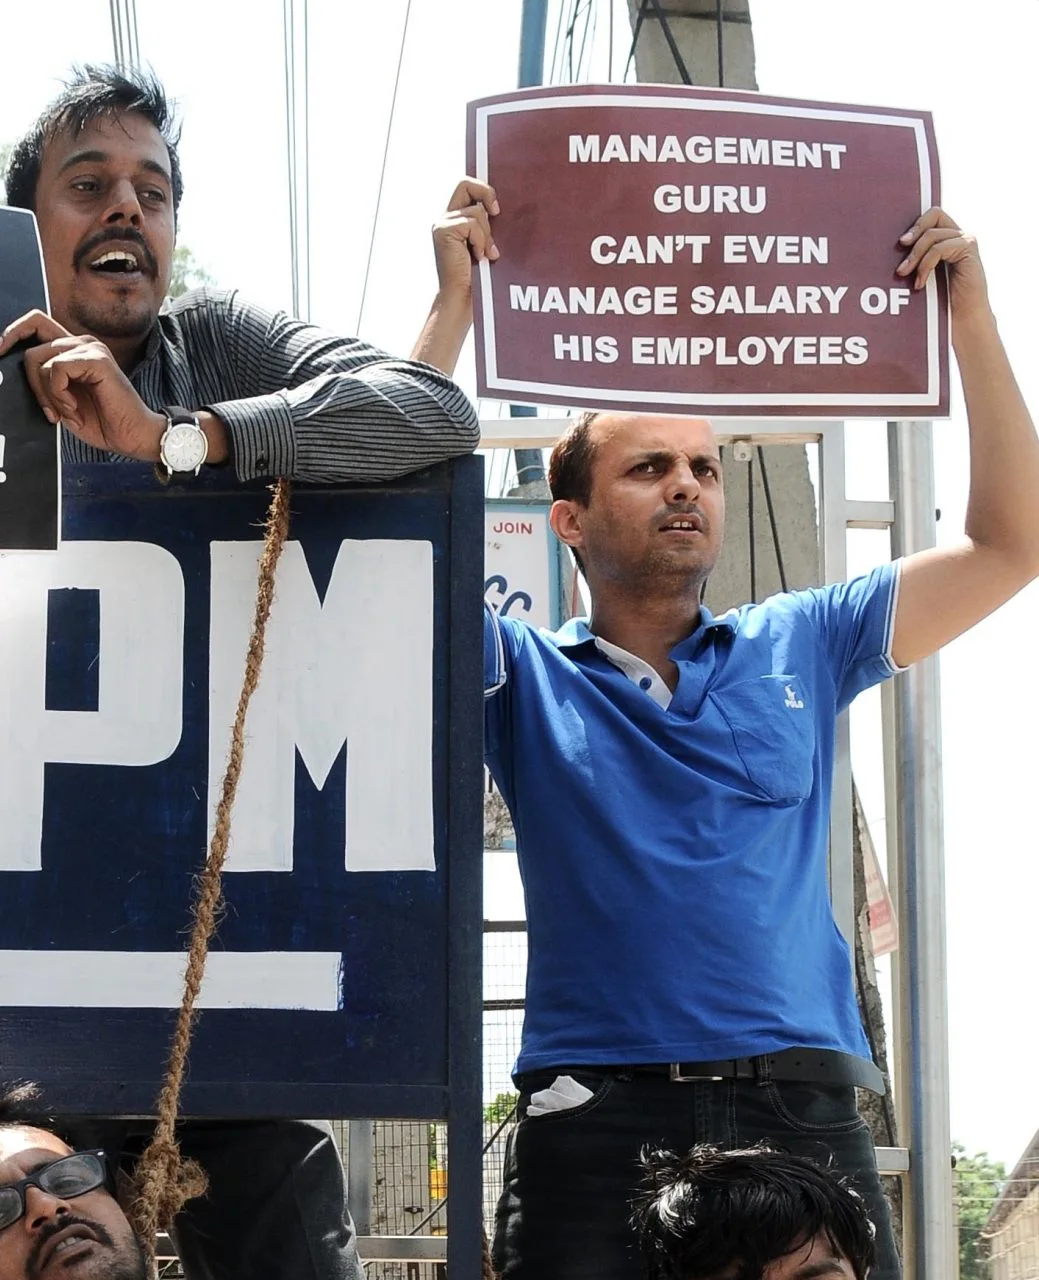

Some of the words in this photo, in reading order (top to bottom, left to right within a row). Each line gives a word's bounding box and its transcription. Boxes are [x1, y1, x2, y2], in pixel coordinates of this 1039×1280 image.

[568, 134, 847, 170] MANAGEMENT
[653, 184, 767, 214] GURU
[590, 235, 711, 265] CAN'T
[723, 235, 829, 265] EVEN
[509, 284, 678, 316] MANAGE
[690, 285, 849, 315] SALARY
[859, 286, 911, 315] OF
[553, 333, 619, 364] HIS
[631, 335, 869, 366] EMPLOYEES
[493, 521, 533, 535] JOIN
